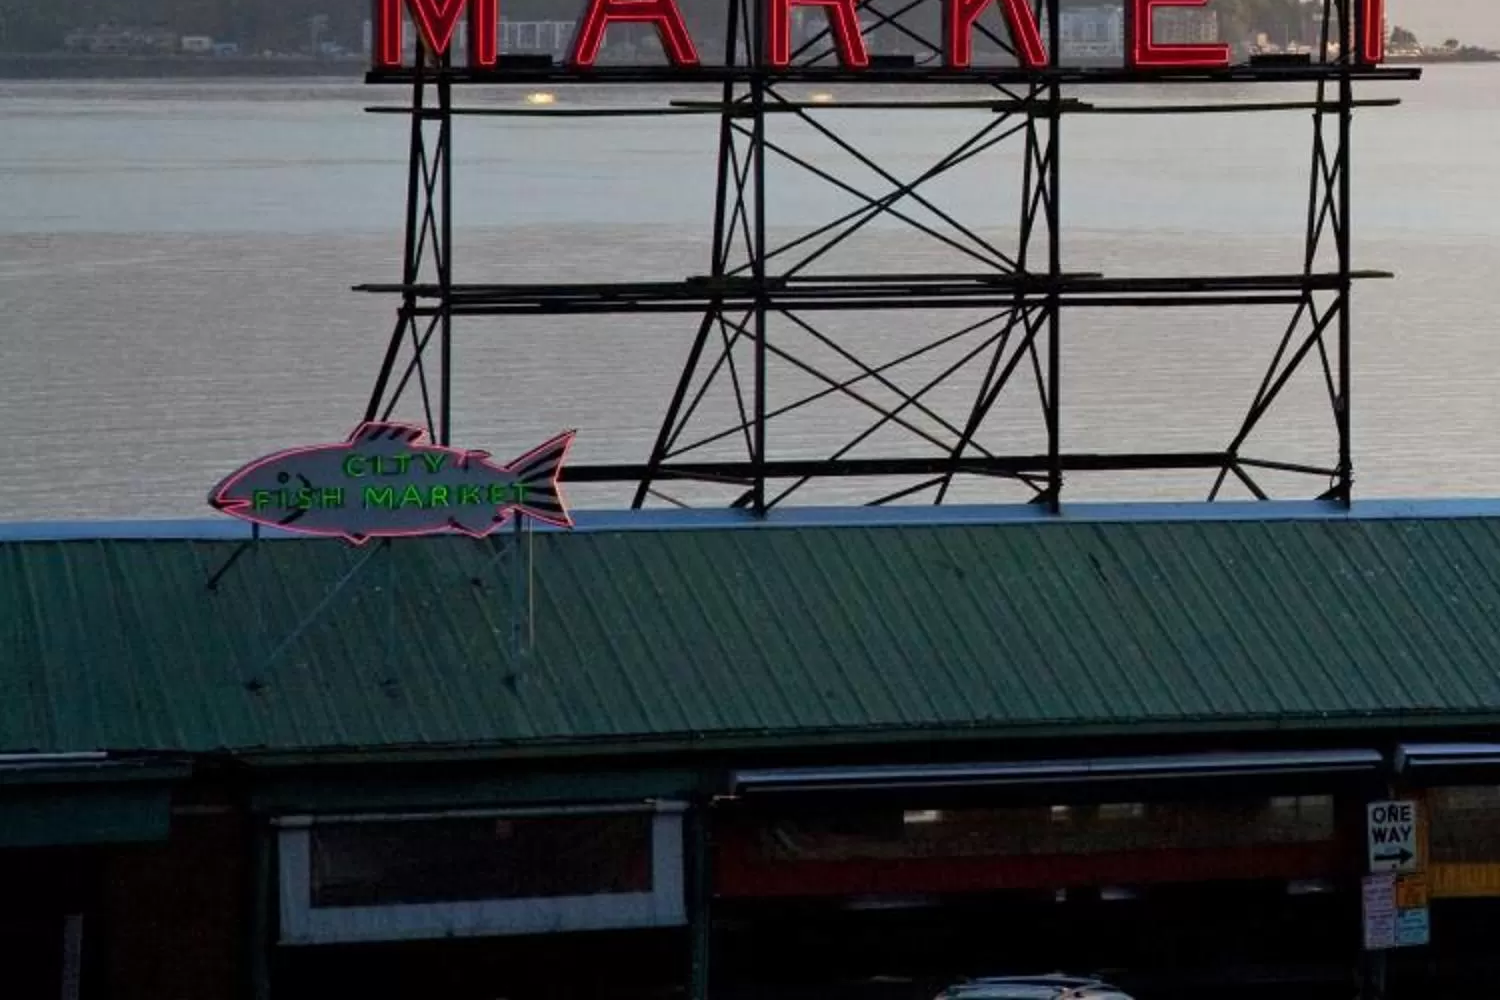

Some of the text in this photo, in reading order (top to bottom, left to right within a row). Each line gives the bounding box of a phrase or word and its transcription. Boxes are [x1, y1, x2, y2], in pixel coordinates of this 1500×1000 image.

[342, 452, 447, 478] CITY
[252, 482, 531, 513] FISH MARKET
[1373, 805, 1411, 824] ONE
[1372, 826, 1411, 844] WAY
